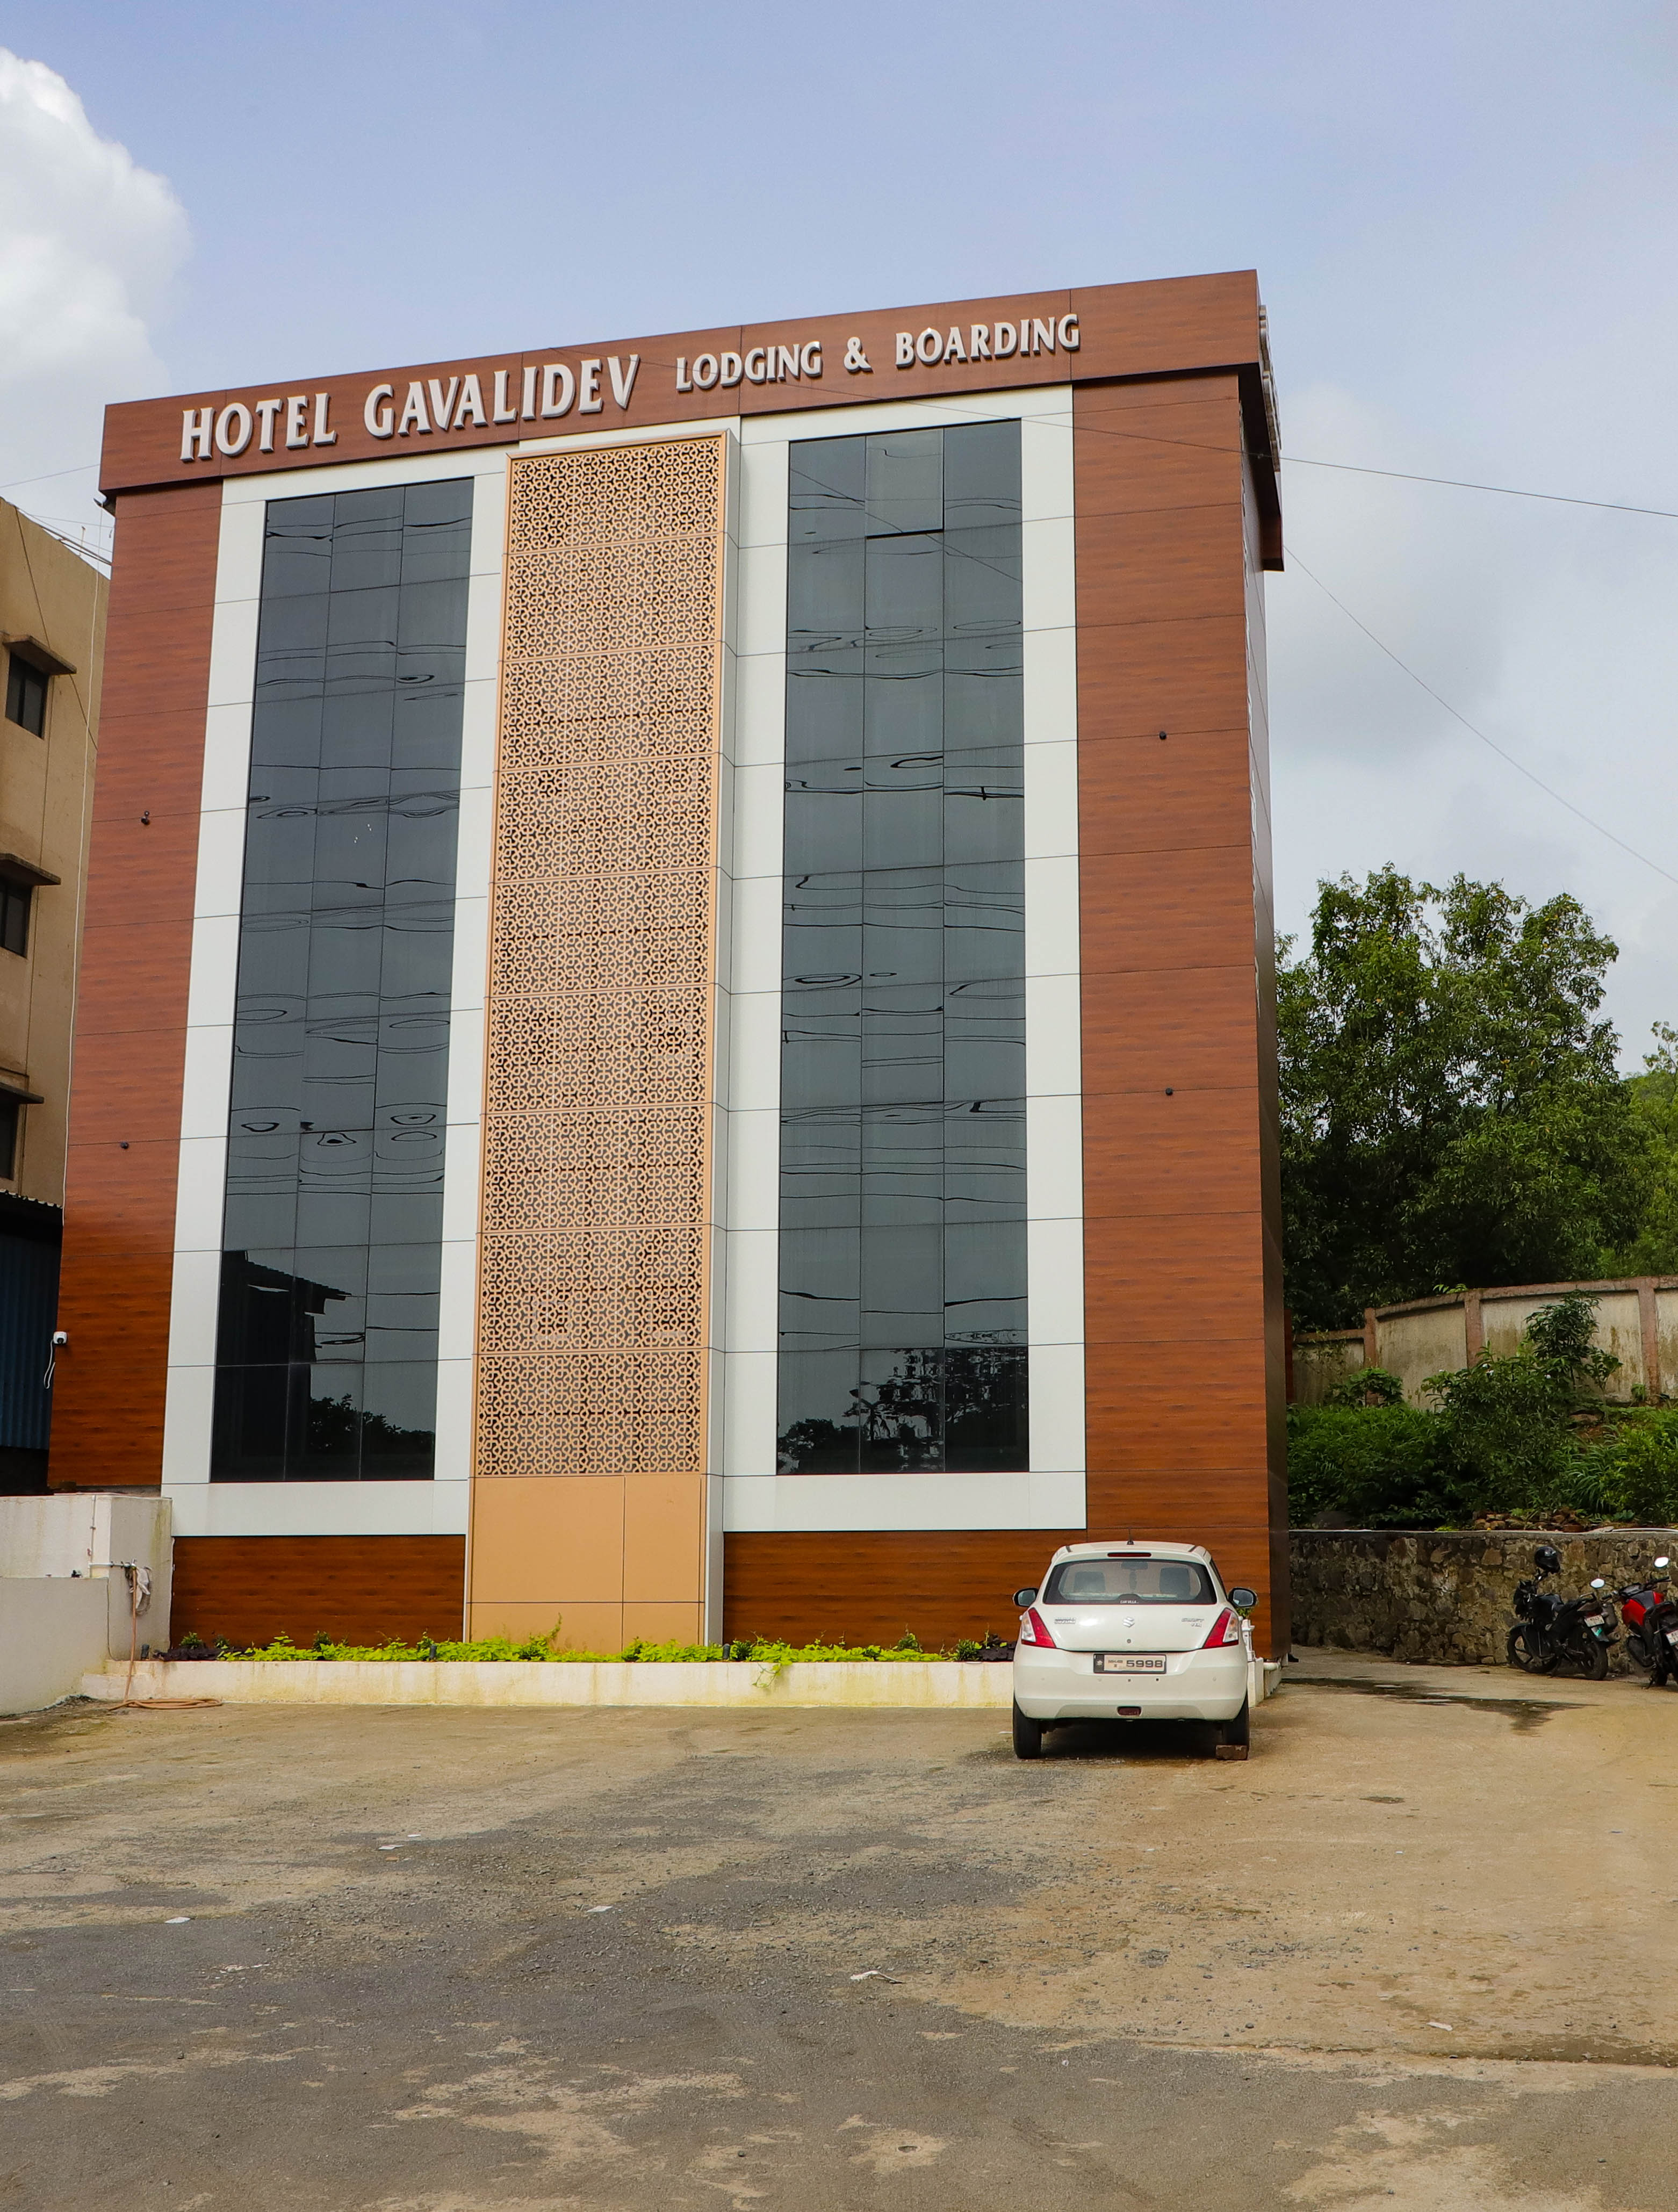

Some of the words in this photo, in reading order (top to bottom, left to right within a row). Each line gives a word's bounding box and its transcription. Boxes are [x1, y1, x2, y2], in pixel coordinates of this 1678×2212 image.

[181, 393, 336, 463] HOTEL
[364, 354, 639, 438] GAVALIDEV
[675, 341, 822, 392] LODGING
[844, 337, 873, 373] &
[896, 314, 1080, 368] BOARDING
[1126, 1660, 1163, 1668] 5998
